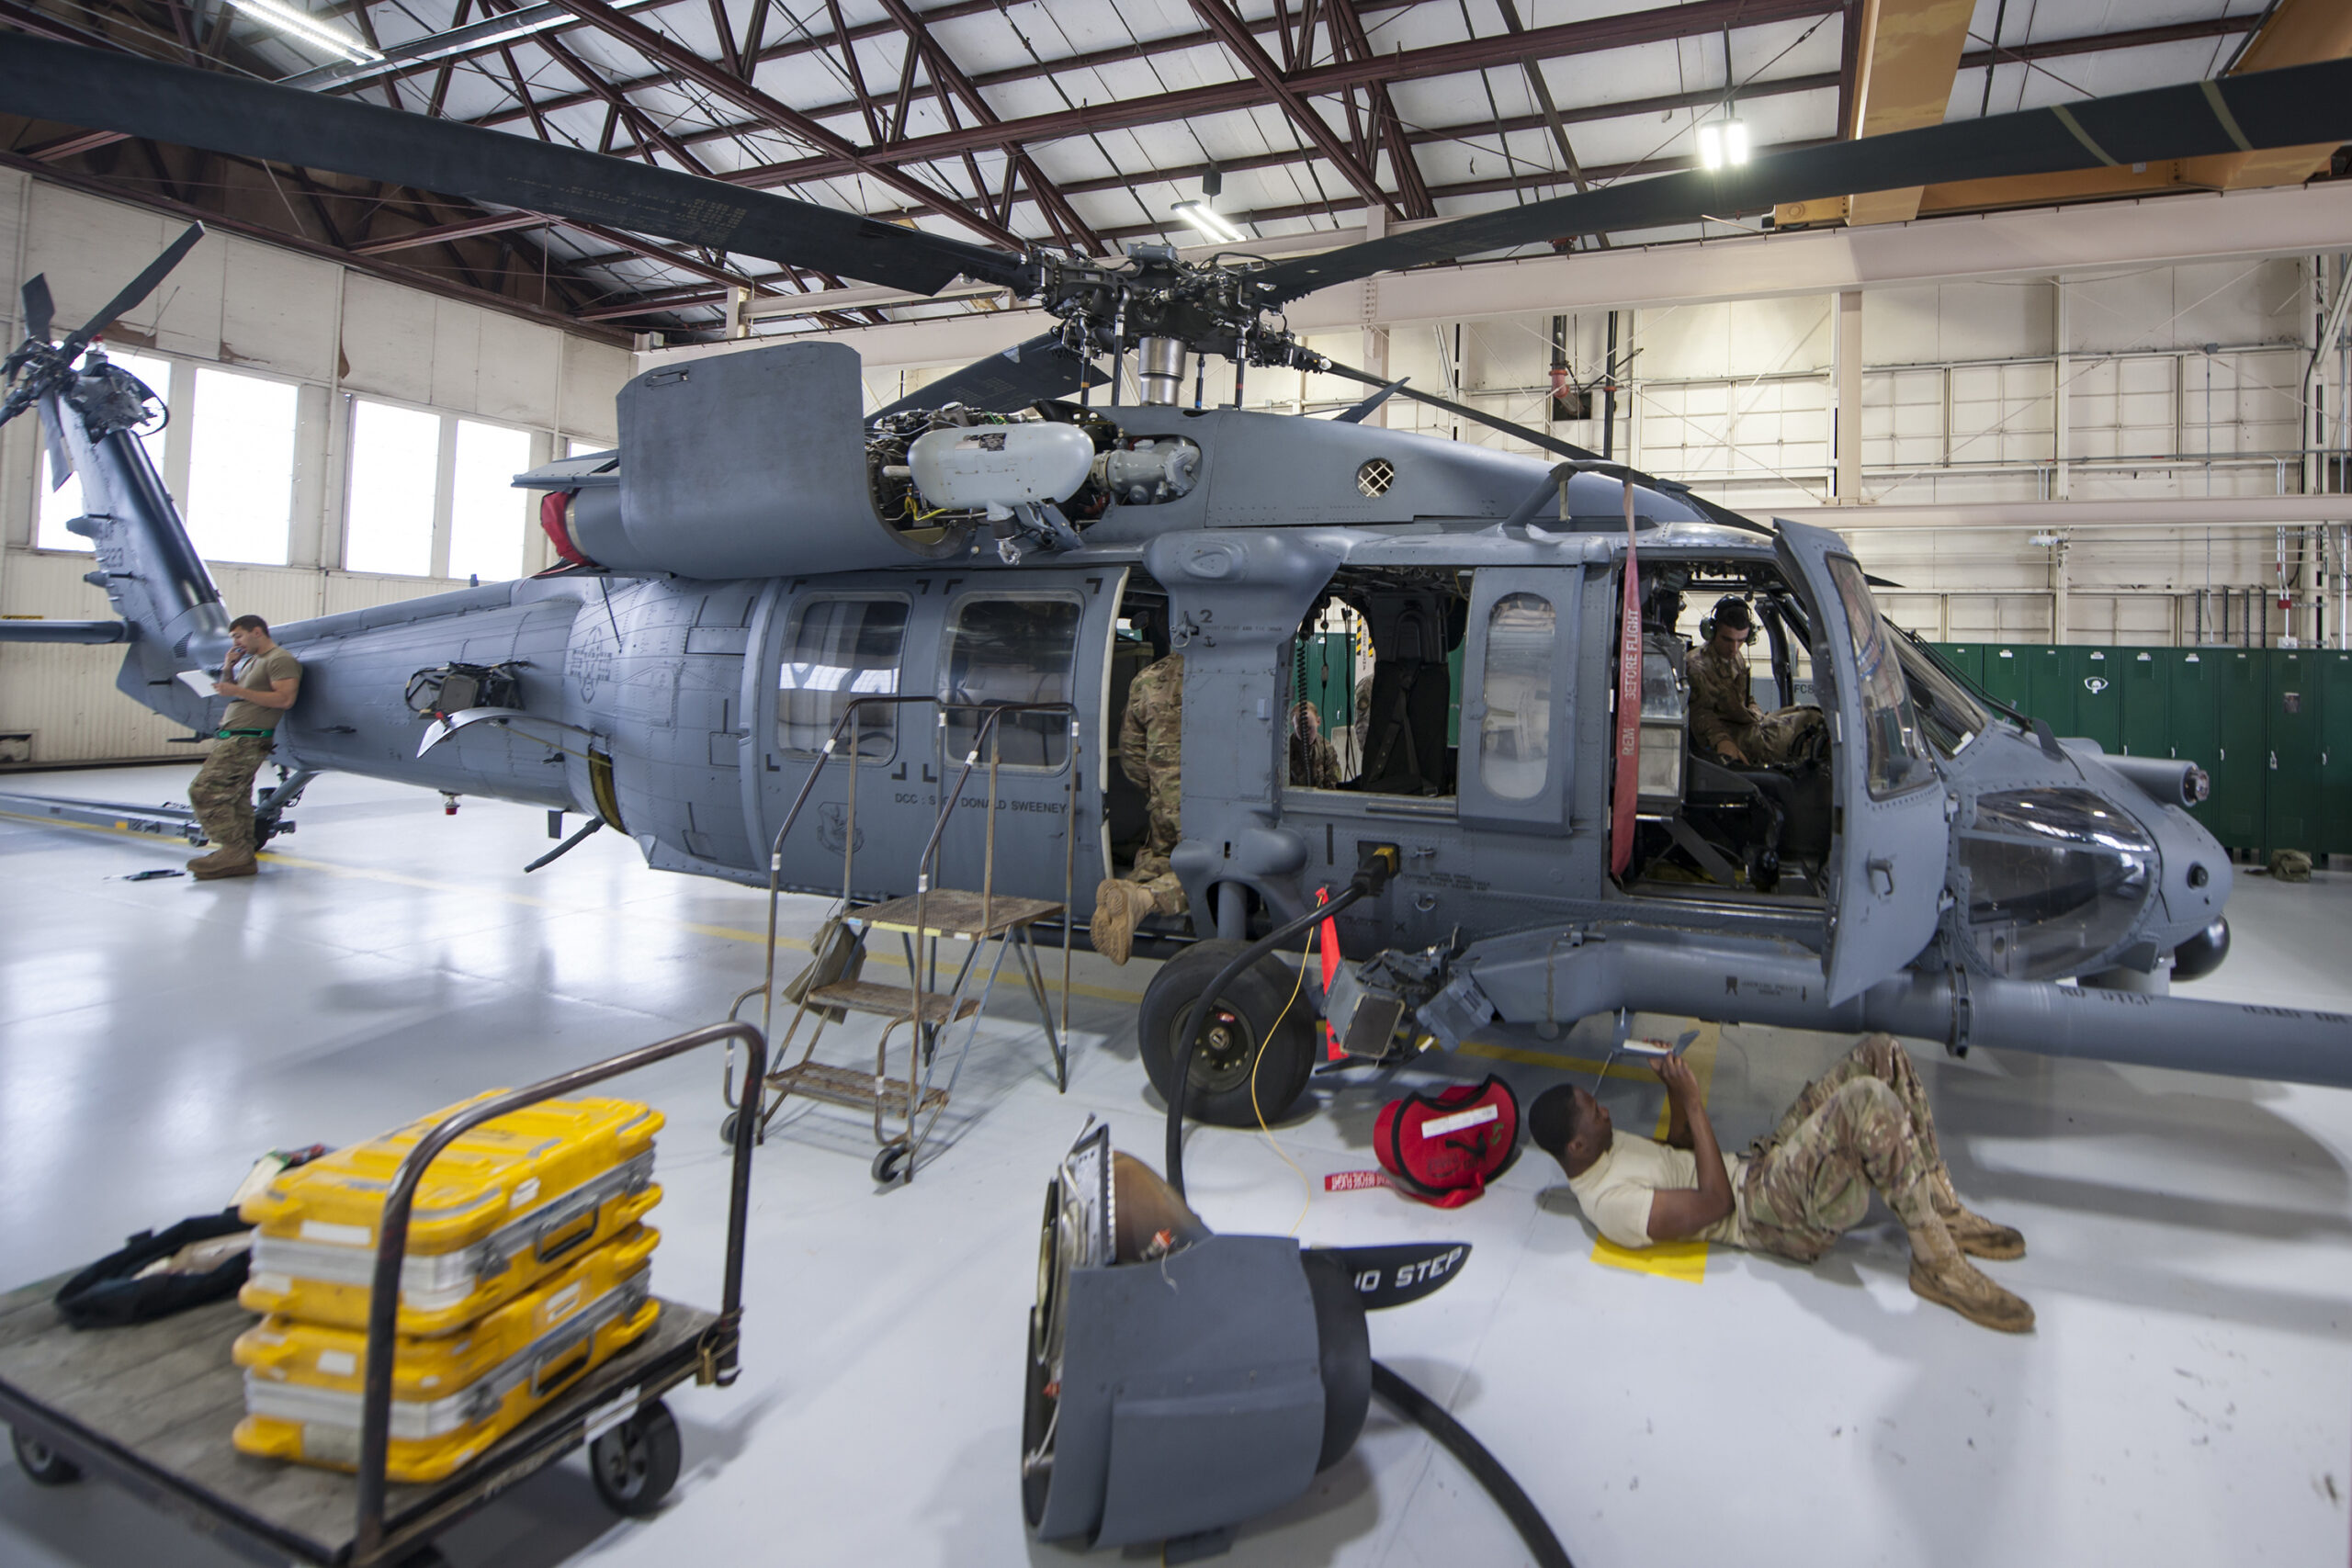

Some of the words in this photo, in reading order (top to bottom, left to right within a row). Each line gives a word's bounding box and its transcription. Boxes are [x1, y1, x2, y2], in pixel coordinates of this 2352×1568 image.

[1199, 609, 1213, 623] 2
[1625, 608, 1639, 651] FLIGHT
[895, 793, 918, 804] DCC
[1012, 800, 1068, 814] SWEENEY
[1395, 1245, 1464, 1289] STEP
